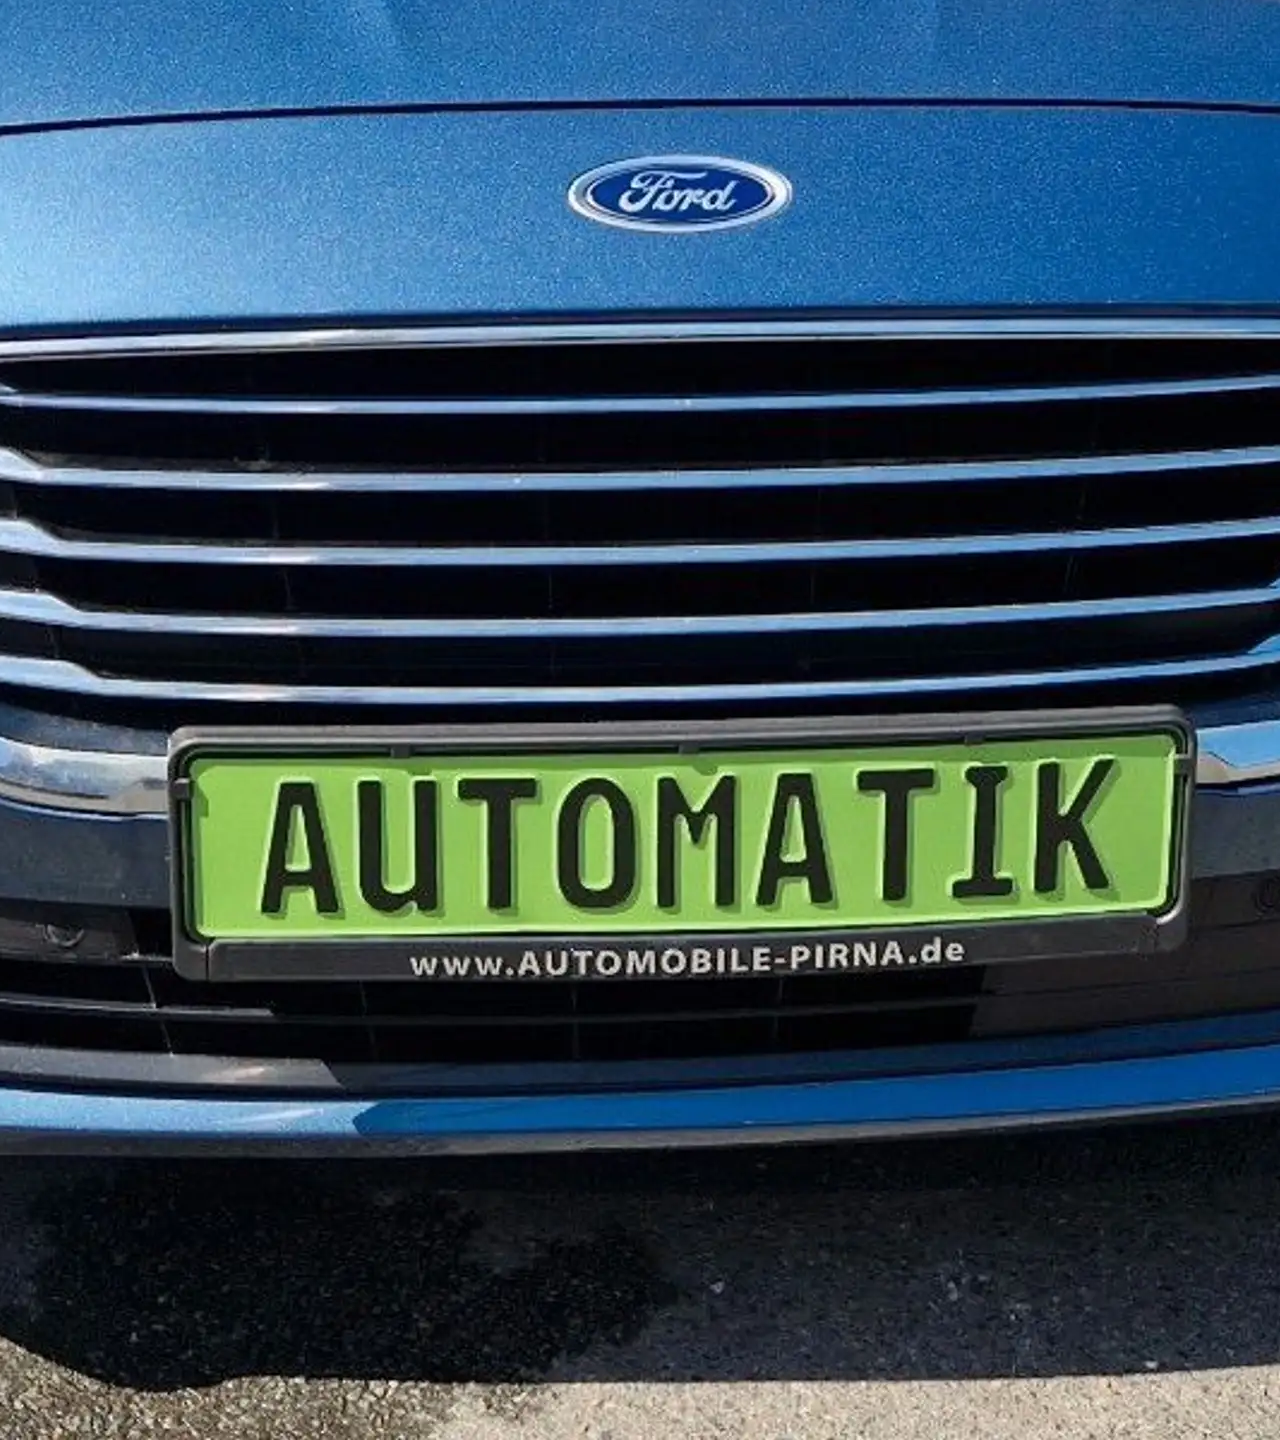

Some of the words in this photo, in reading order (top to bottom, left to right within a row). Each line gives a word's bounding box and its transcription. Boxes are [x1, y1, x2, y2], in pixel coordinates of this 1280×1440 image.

[618, 170, 741, 212] Ford
[260, 758, 1116, 914] AUTOMATIK
[410, 936, 966, 977] www.AUTOMOBILE-PIRNA.de
